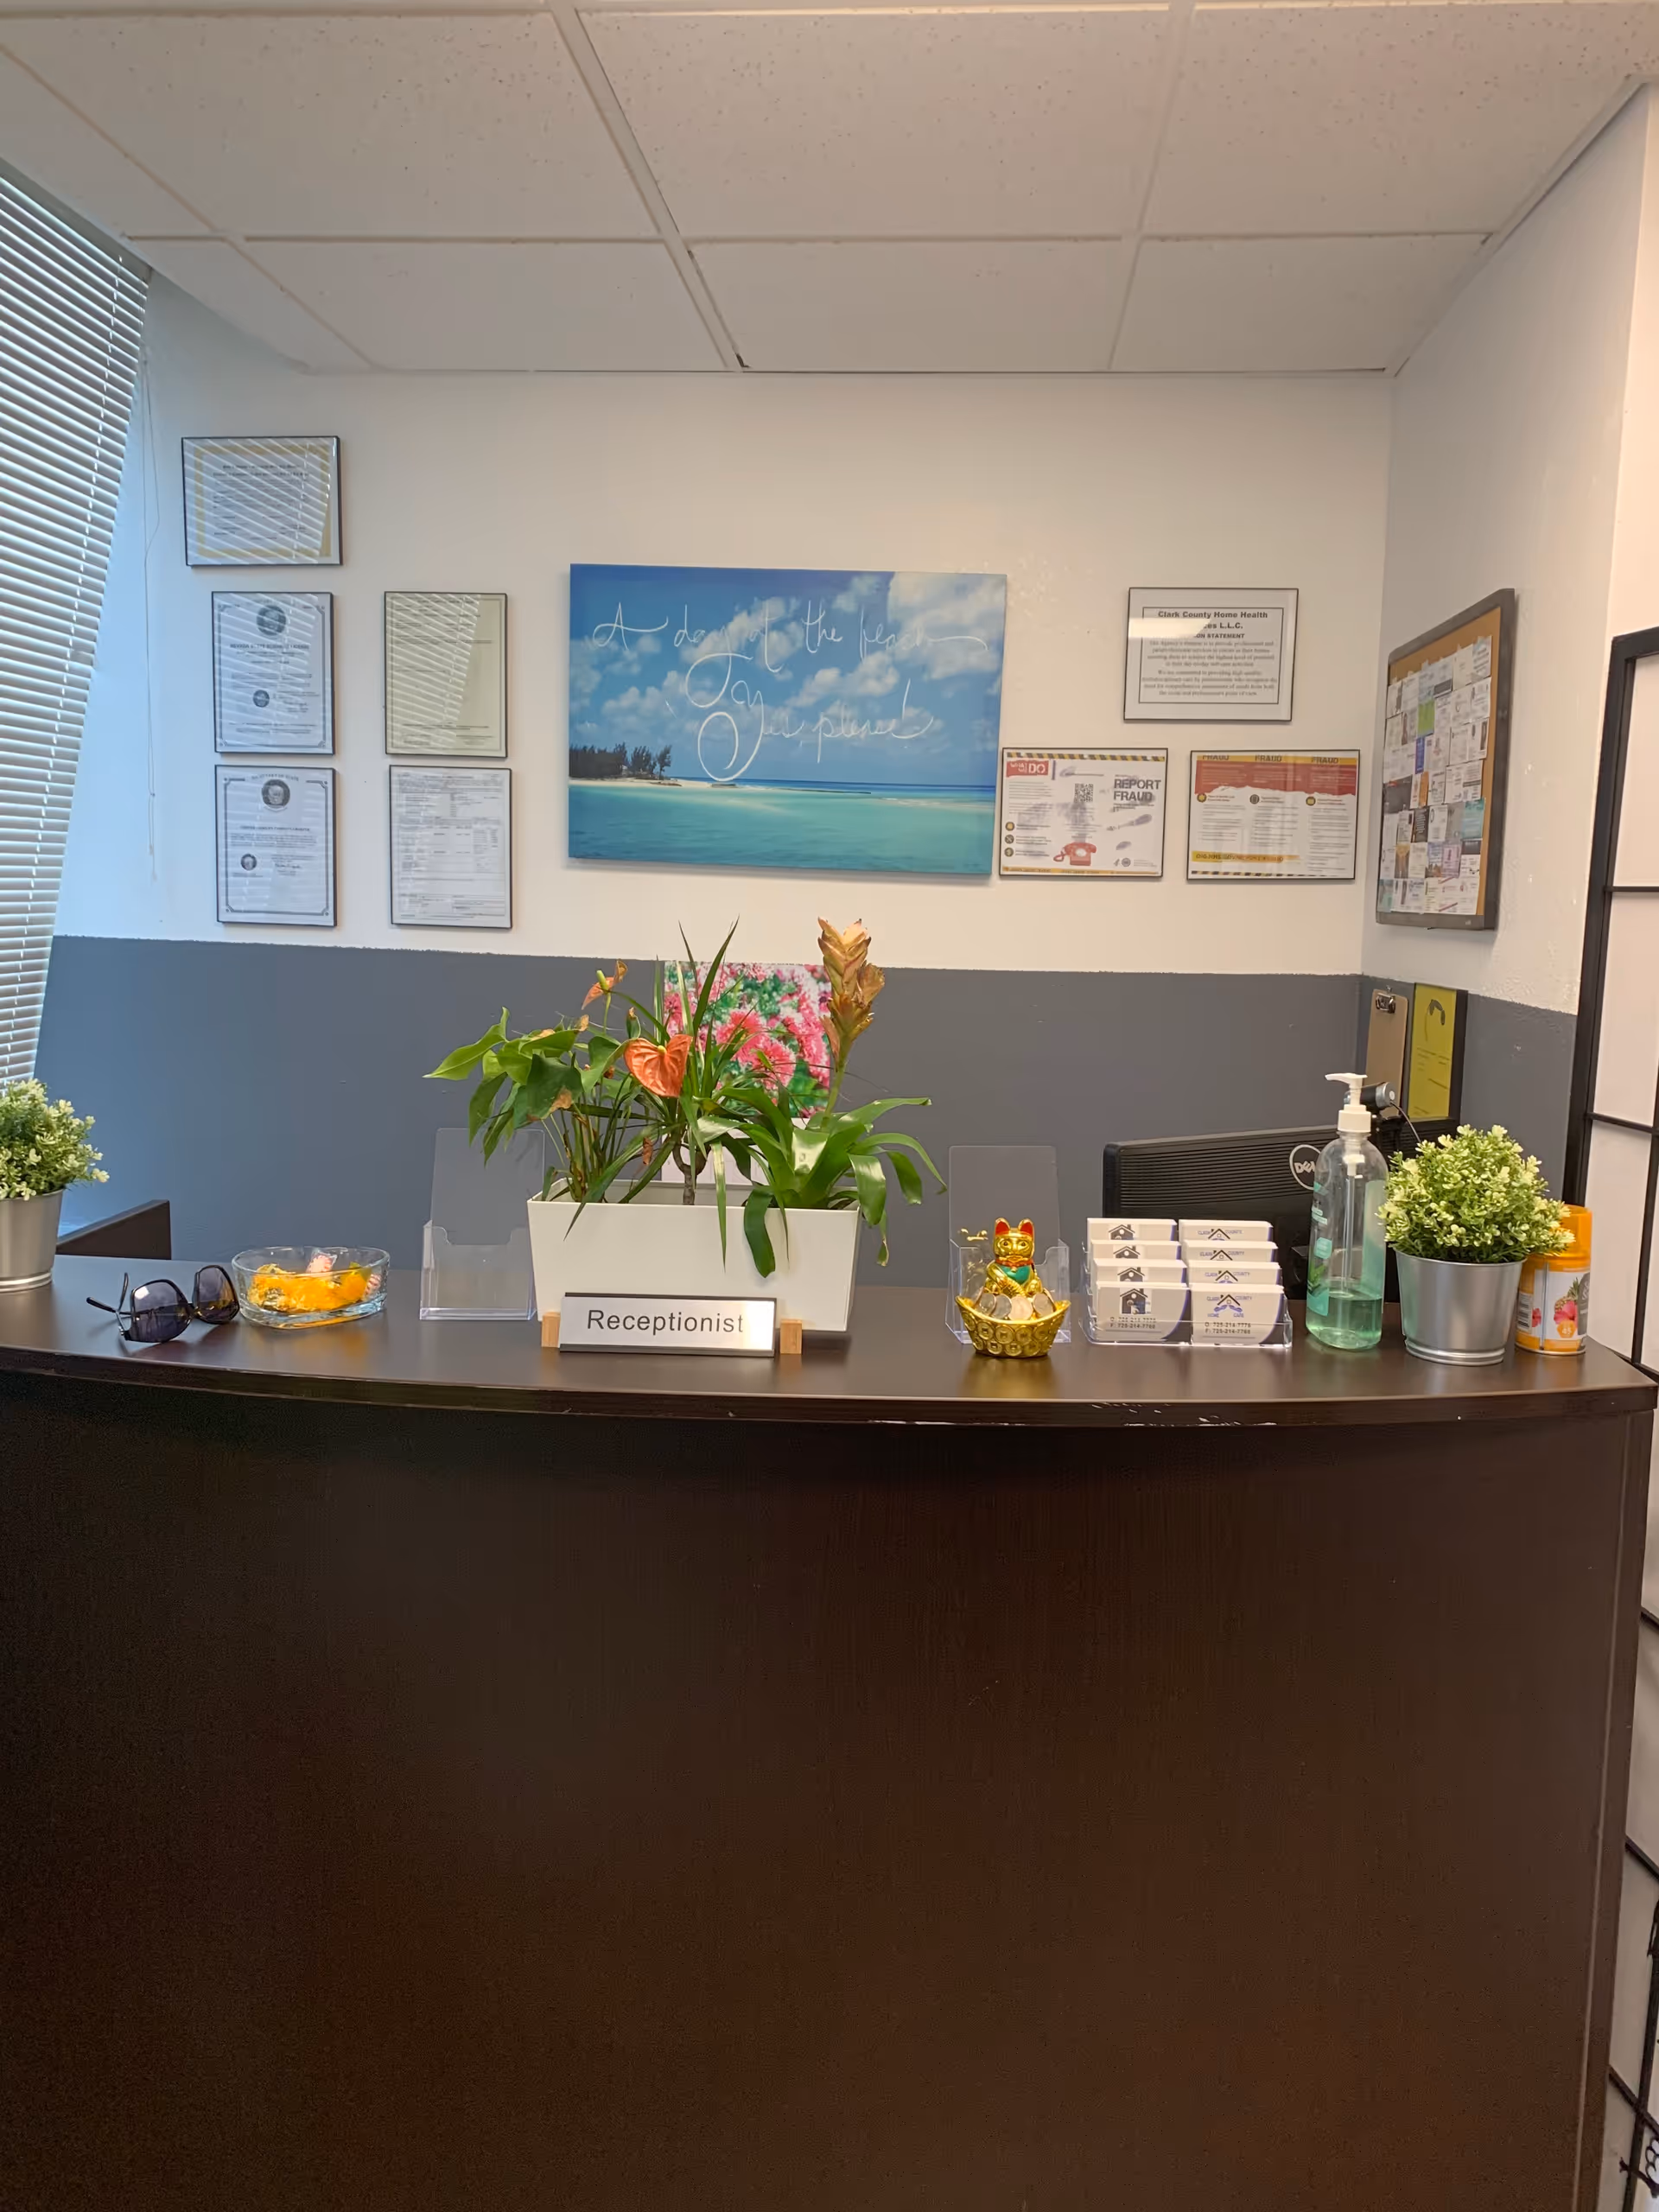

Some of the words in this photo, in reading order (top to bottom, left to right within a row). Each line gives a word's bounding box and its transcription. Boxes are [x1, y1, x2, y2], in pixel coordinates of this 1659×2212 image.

[1182, 611, 1211, 620] County
[1028, 763, 1046, 774] DO
[1114, 779, 1162, 791] REPORT
[1113, 791, 1154, 802] FRAUD
[587, 1309, 744, 1336] Receptionist
